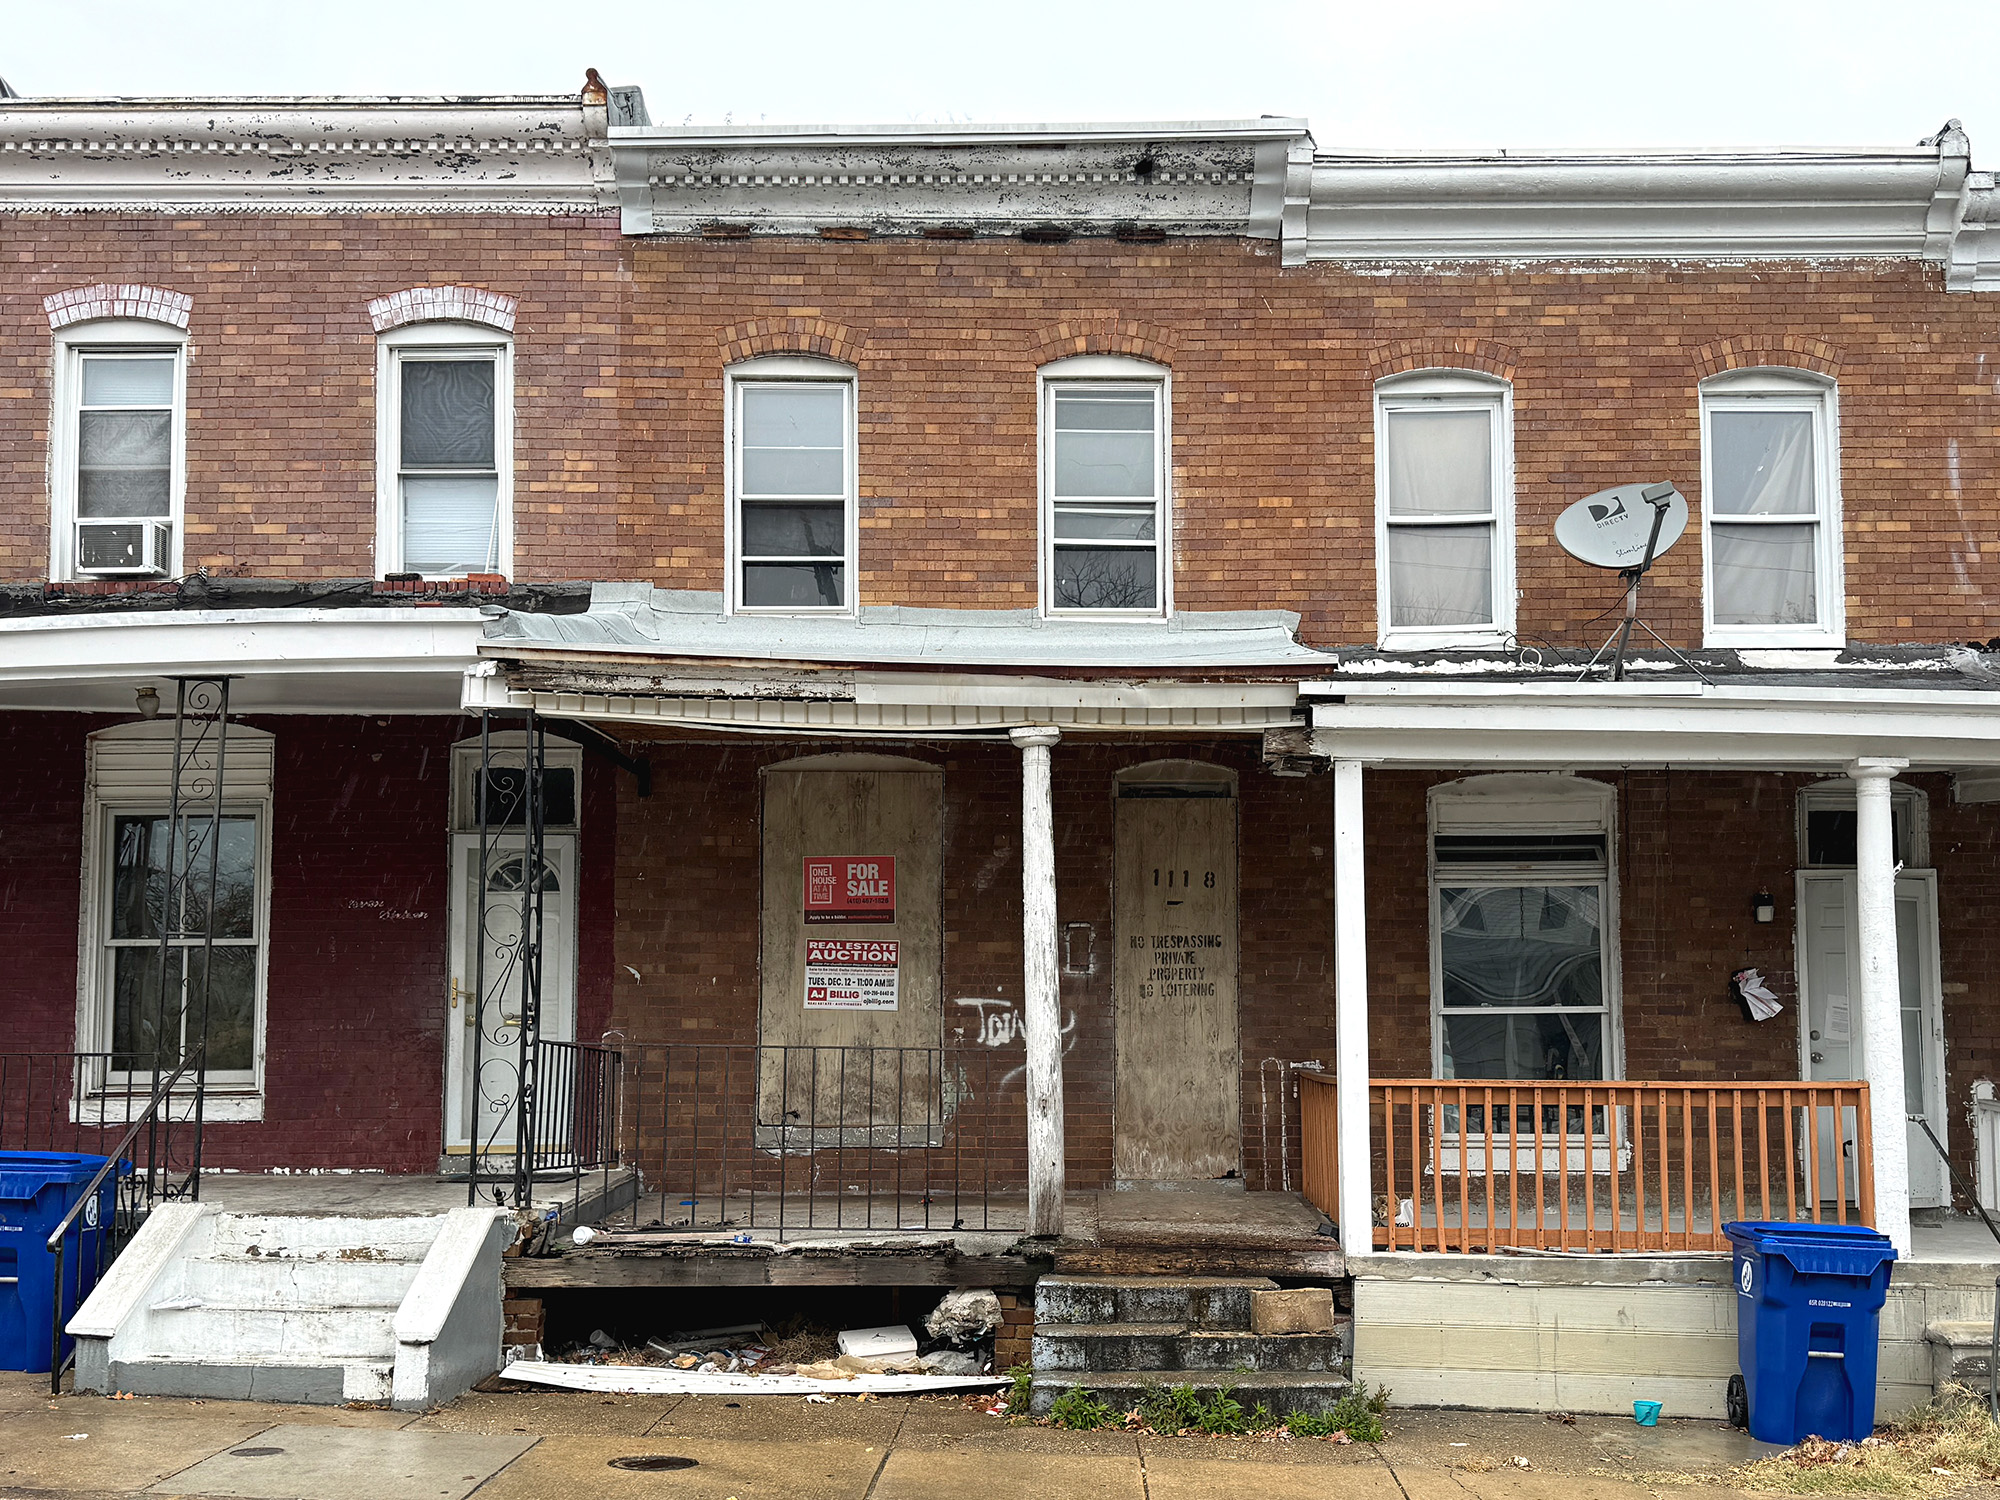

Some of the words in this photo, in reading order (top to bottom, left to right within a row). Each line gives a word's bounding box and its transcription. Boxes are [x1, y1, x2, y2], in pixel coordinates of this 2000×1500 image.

[1596, 513, 1629, 529] DIRECTV
[812, 868, 828, 876] ONE
[847, 863, 879, 879] FOR
[812, 876, 837, 885] HOUSE
[1153, 868, 1216, 889] 1118
[846, 880, 889, 896] SALE
[809, 941, 843, 950] REAL
[845, 942, 897, 951] ESTATE
[1130, 935, 1145, 949] NO
[1151, 934, 1222, 949] TRESPASSING
[809, 949, 897, 962] AUCTION
[1154, 951, 1196, 965] PRIVATE
[1148, 966, 1205, 981] PROPERTY
[808, 977, 827, 986] TUES.
[827, 977, 844, 986] DEC.
[844, 978, 851, 986] 12
[857, 978, 873, 987] 11:00
[874, 979, 886, 987] AM
[810, 989, 825, 999] AJ
[829, 990, 860, 999] BILLIG
[1160, 982, 1215, 997] LOITERING
